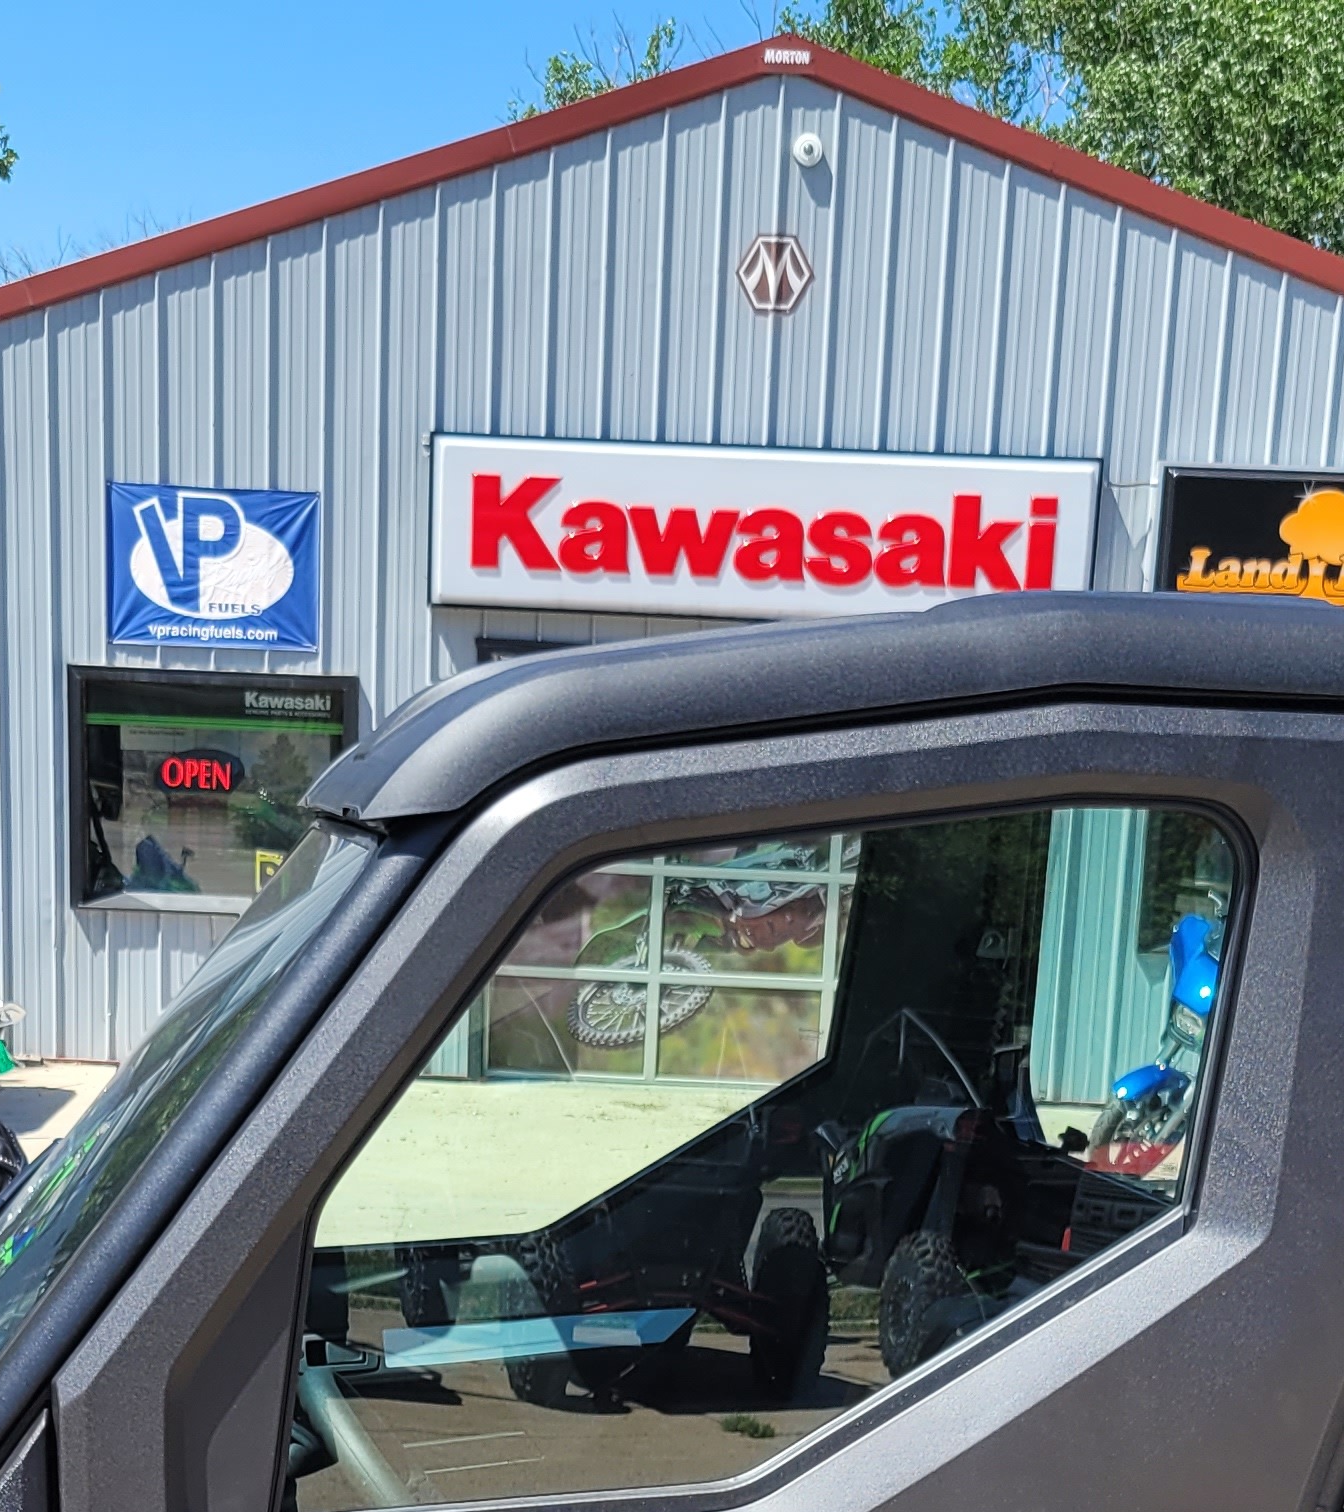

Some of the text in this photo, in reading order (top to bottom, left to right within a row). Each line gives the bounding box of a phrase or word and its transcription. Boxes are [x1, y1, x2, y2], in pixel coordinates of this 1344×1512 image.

[764, 49, 811, 65] MORTON
[471, 473, 1059, 592] Kawasaki
[132, 490, 245, 613] VP
[1183, 546, 1302, 590] Land
[208, 602, 262, 615] FUELS
[148, 624, 278, 641] vpracingfuels.com
[245, 691, 331, 710] Kawasaki
[161, 757, 233, 791] OPEN
